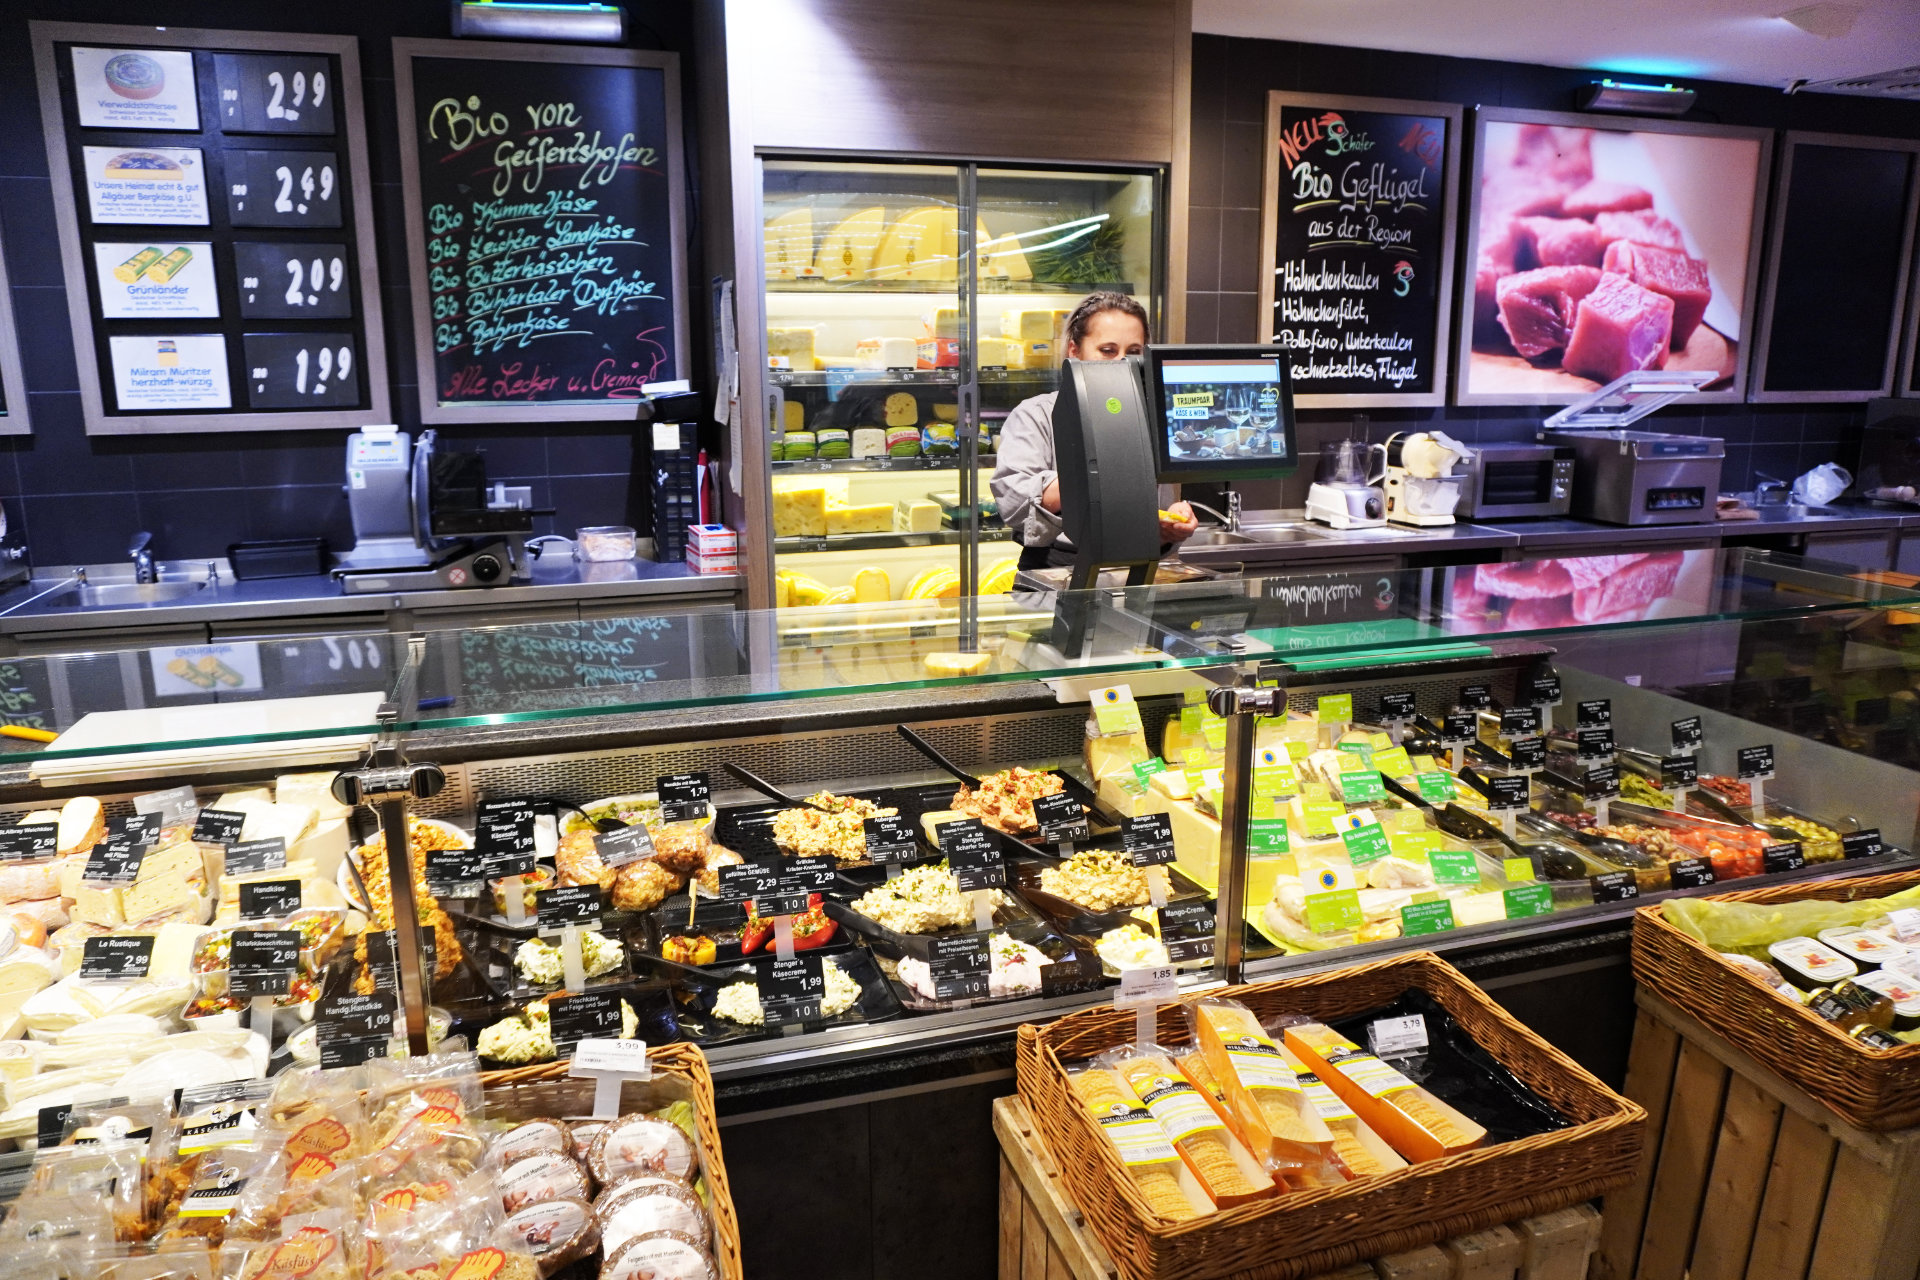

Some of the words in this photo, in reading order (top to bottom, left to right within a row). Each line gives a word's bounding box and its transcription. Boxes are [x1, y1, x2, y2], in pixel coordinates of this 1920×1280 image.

[430, 95, 509, 151] Bio
[526, 102, 582, 131] von
[1280, 118, 1326, 171] NEU
[1291, 161, 1333, 200] Bio
[1338, 160, 1429, 213] Geflügel
[428, 203, 463, 235] Bio
[472, 190, 597, 233] Kümmelkäse
[1308, 220, 1334, 238] aus
[1337, 215, 1363, 239] der
[1365, 214, 1412, 250] Region
[428, 236, 461, 263] Bio
[467, 228, 543, 262] Leichter
[546, 215, 636, 255] Landkäse
[429, 265, 462, 293] Bio
[127, 285, 190, 295] Grünländer
[433, 293, 459, 320] Bio
[573, 271, 656, 315] Dorfkäse
[436, 323, 463, 353] Bio
[1345, 331, 1413, 352] Unterkeulen
[130, 368, 166, 377] Milram
[1376, 356, 1418, 389] Flügel
[443, 364, 488, 398] Alle
[492, 362, 560, 401] Lecker
[1176, 396, 1211, 406] TRAUMPAAR
[1175, 409, 1188, 418] KÄSE
[690, 786, 708, 797] 1.79
[514, 810, 534, 822] 2.79
[1064, 803, 1081, 816] 1.99
[490, 823, 517, 832] Stengers
[1153, 828, 1171, 840] 1.99
[896, 829, 914, 840] 2.39
[33, 837, 57, 850] 2.59
[513, 837, 534, 849] 1.99
[981, 850, 1001, 863] 1.79
[747, 867, 771, 877] GEMÜSE
[814, 871, 835, 885] 2.29
[756, 878, 777, 891] 2.29
[1620, 885, 1637, 899] 2.29
[278, 897, 300, 910] 1.29
[577, 902, 600, 916] 2.49
[1164, 905, 1206, 918] Mango-Creme
[1194, 919, 1214, 933] 1.99
[98, 940, 108, 948] Le
[109, 939, 142, 949] Rustique
[123, 955, 149, 968] 2.99
[272, 950, 298, 963] 2.69
[968, 953, 989, 967] 1.99
[772, 968, 807, 979] Käsecreme
[1152, 968, 1171, 979] 1,85
[799, 976, 822, 991] 1.99
[337, 995, 370, 1006] Stengers
[568, 995, 599, 1005] Frischkäse
[568, 1003, 585, 1012] Feige
[596, 999, 610, 1007] Senf
[364, 1013, 391, 1030] 1.09
[595, 1011, 620, 1026] 1.99
[1402, 1019, 1421, 1029] 3,79
